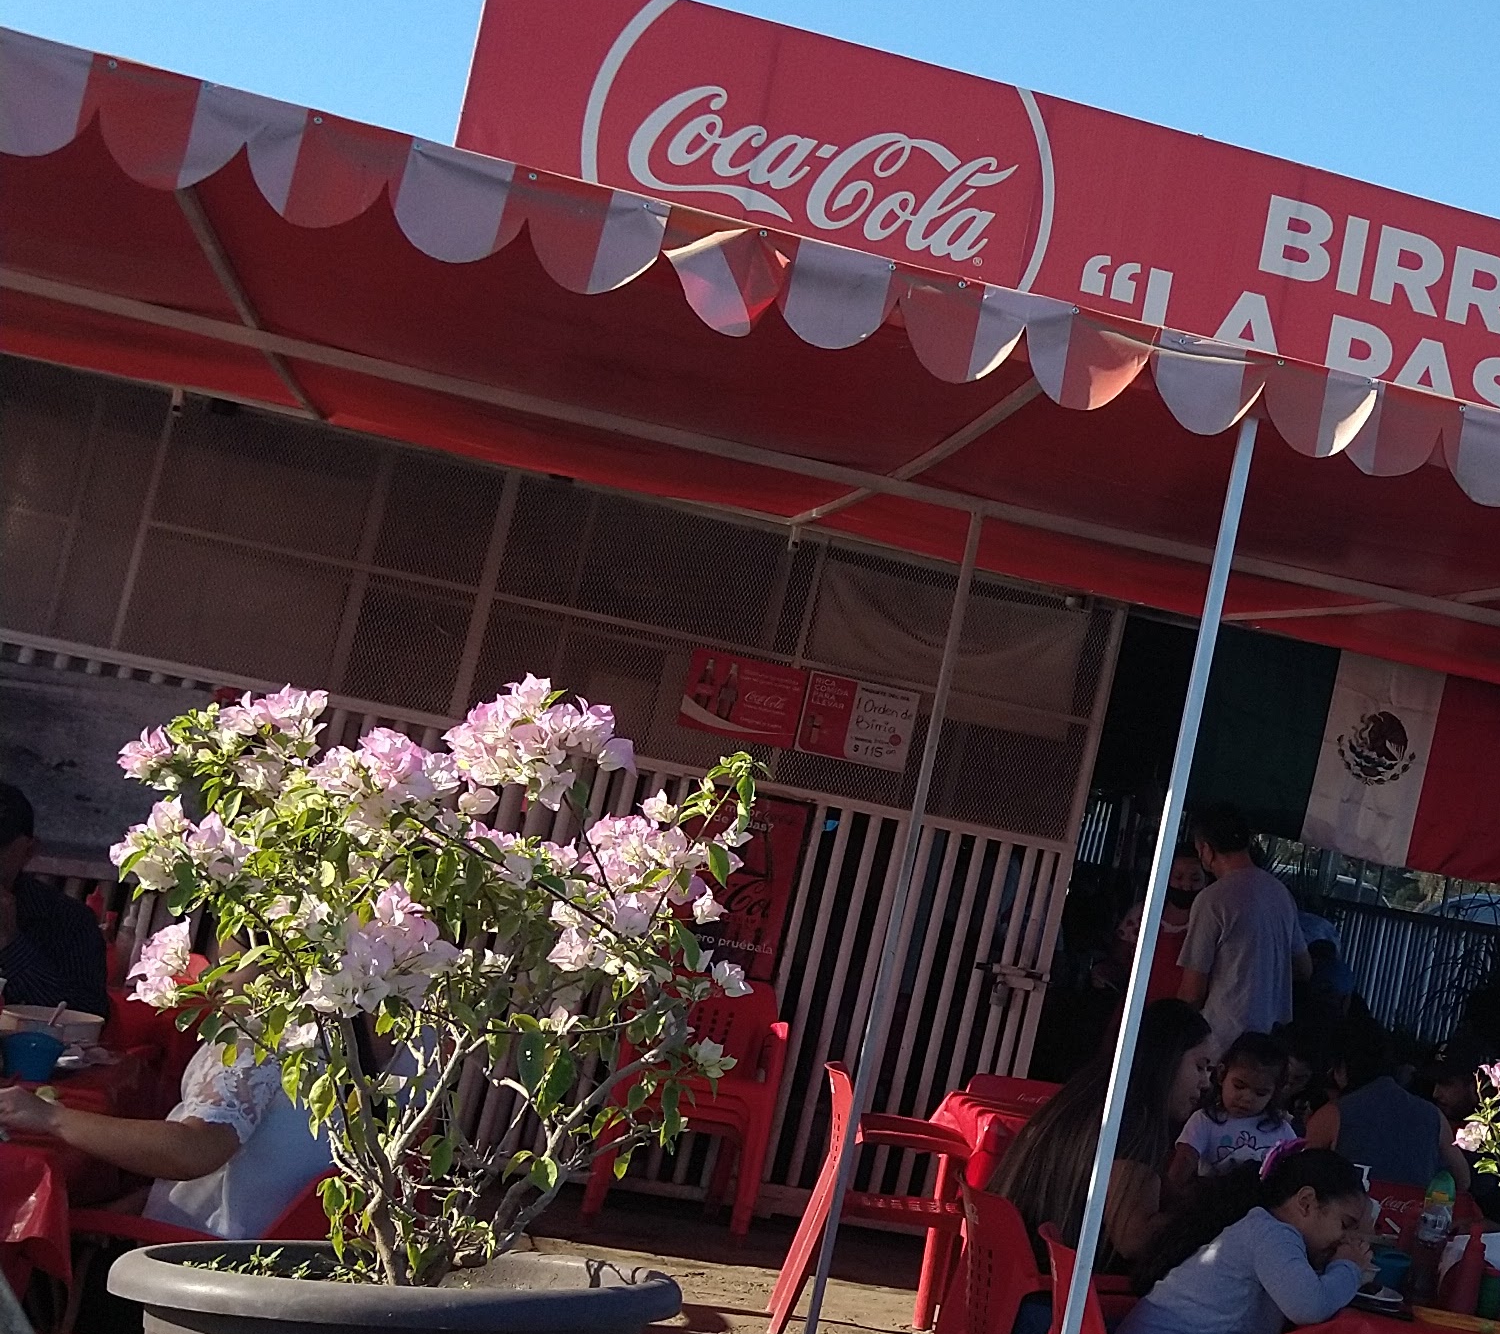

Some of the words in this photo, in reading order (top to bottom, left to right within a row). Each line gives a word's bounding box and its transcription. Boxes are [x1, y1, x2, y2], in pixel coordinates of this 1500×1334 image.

[628, 85, 1019, 264] Coca-Cola
[863, 699, 898, 718] Orden
[900, 709, 913, 721] de
[855, 714, 896, 734] Birria
[717, 936, 773, 955] pruébala
